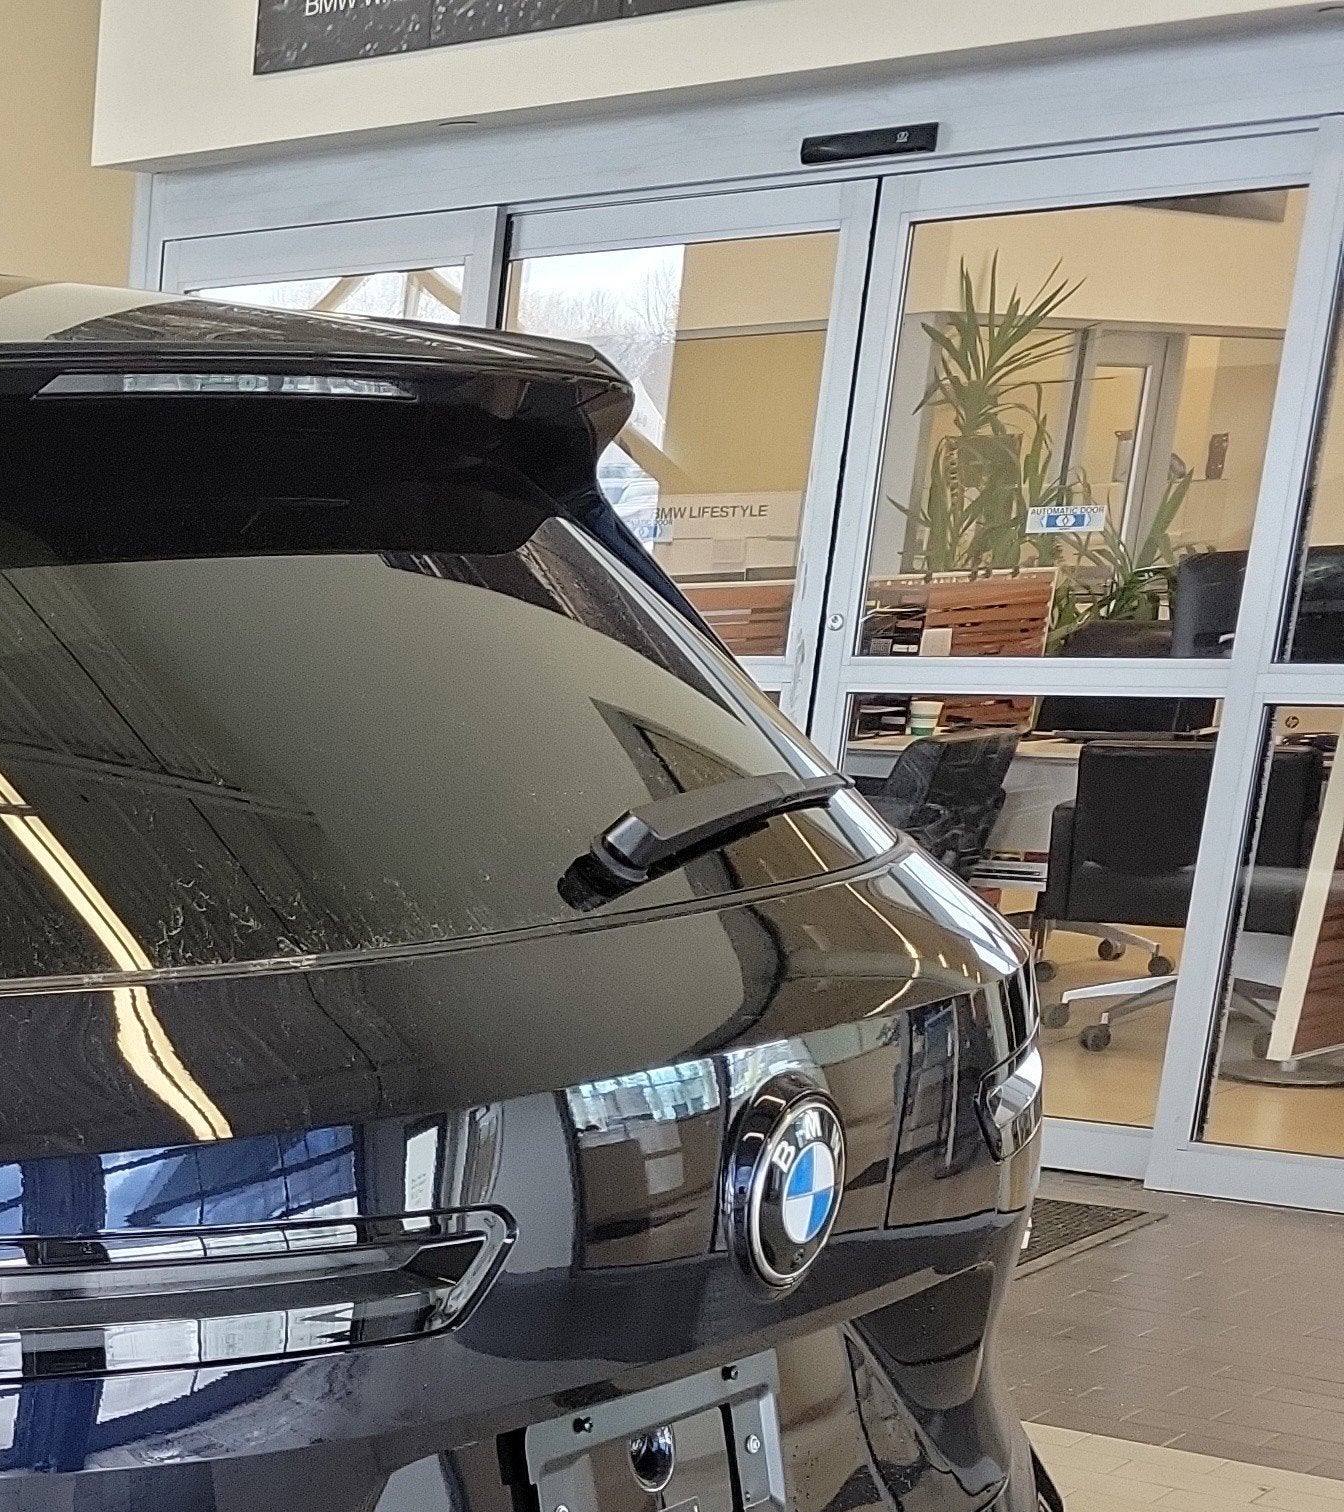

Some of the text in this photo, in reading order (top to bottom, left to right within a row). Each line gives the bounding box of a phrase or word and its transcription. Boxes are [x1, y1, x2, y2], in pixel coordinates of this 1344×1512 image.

[653, 504, 769, 520] BMW LIFESTYLE
[1030, 506, 1105, 515] AUTOMATIC DOOR
[771, 1107, 844, 1175] BMW
